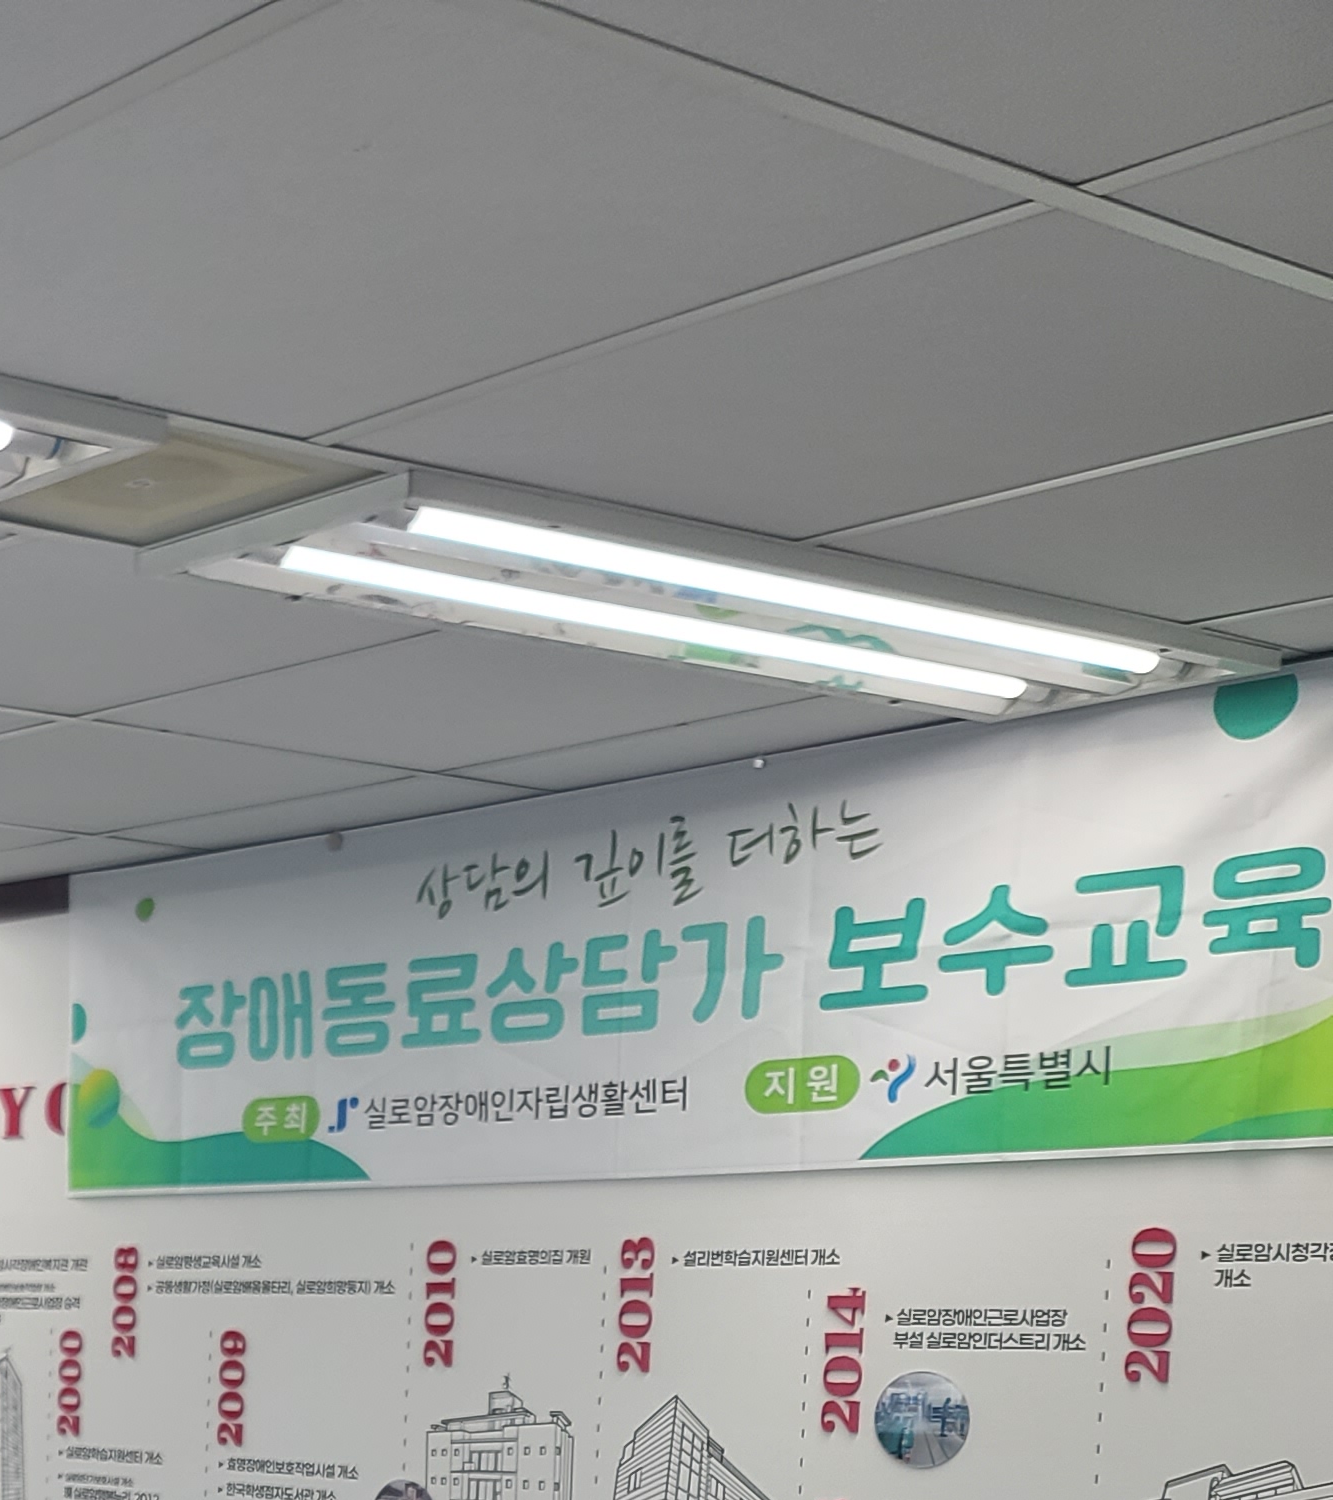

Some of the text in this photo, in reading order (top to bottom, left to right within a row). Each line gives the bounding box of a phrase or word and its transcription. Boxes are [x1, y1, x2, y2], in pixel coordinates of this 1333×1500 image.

[415, 801, 885, 920] 상담의 깊이를 더하는
[173, 846, 1332, 1070] 장애동료상담가 보수교육
[252, 1046, 1114, 1140] 주최 실로암장애인자립생활센터 지원 서울특별시
[111, 1247, 138, 1359] 2008
[241, 1254, 262, 1269] 개소
[374, 1281, 395, 1296] 개소
[423, 1239, 457, 1368] 2010
[481, 1248, 591, 1266] 실로암효명의집 개원
[683, 1248, 841, 1268] 설리번학습지원센터 개소
[1214, 1268, 1253, 1289] 개소
[616, 1236, 655, 1374] 2013
[893, 1331, 1087, 1352] 부설 실로암인더스트리 개소
[896, 1308, 1068, 1327] 실로암장애인근로사업장
[1124, 1227, 1177, 1384] 2020
[57, 1330, 83, 1437] 2000
[217, 1330, 246, 1447] 2009
[820, 1287, 867, 1435] 2014
[145, 1451, 163, 1465] 개소
[227, 1457, 359, 1479] 효명장애인보호작업시설 개소
